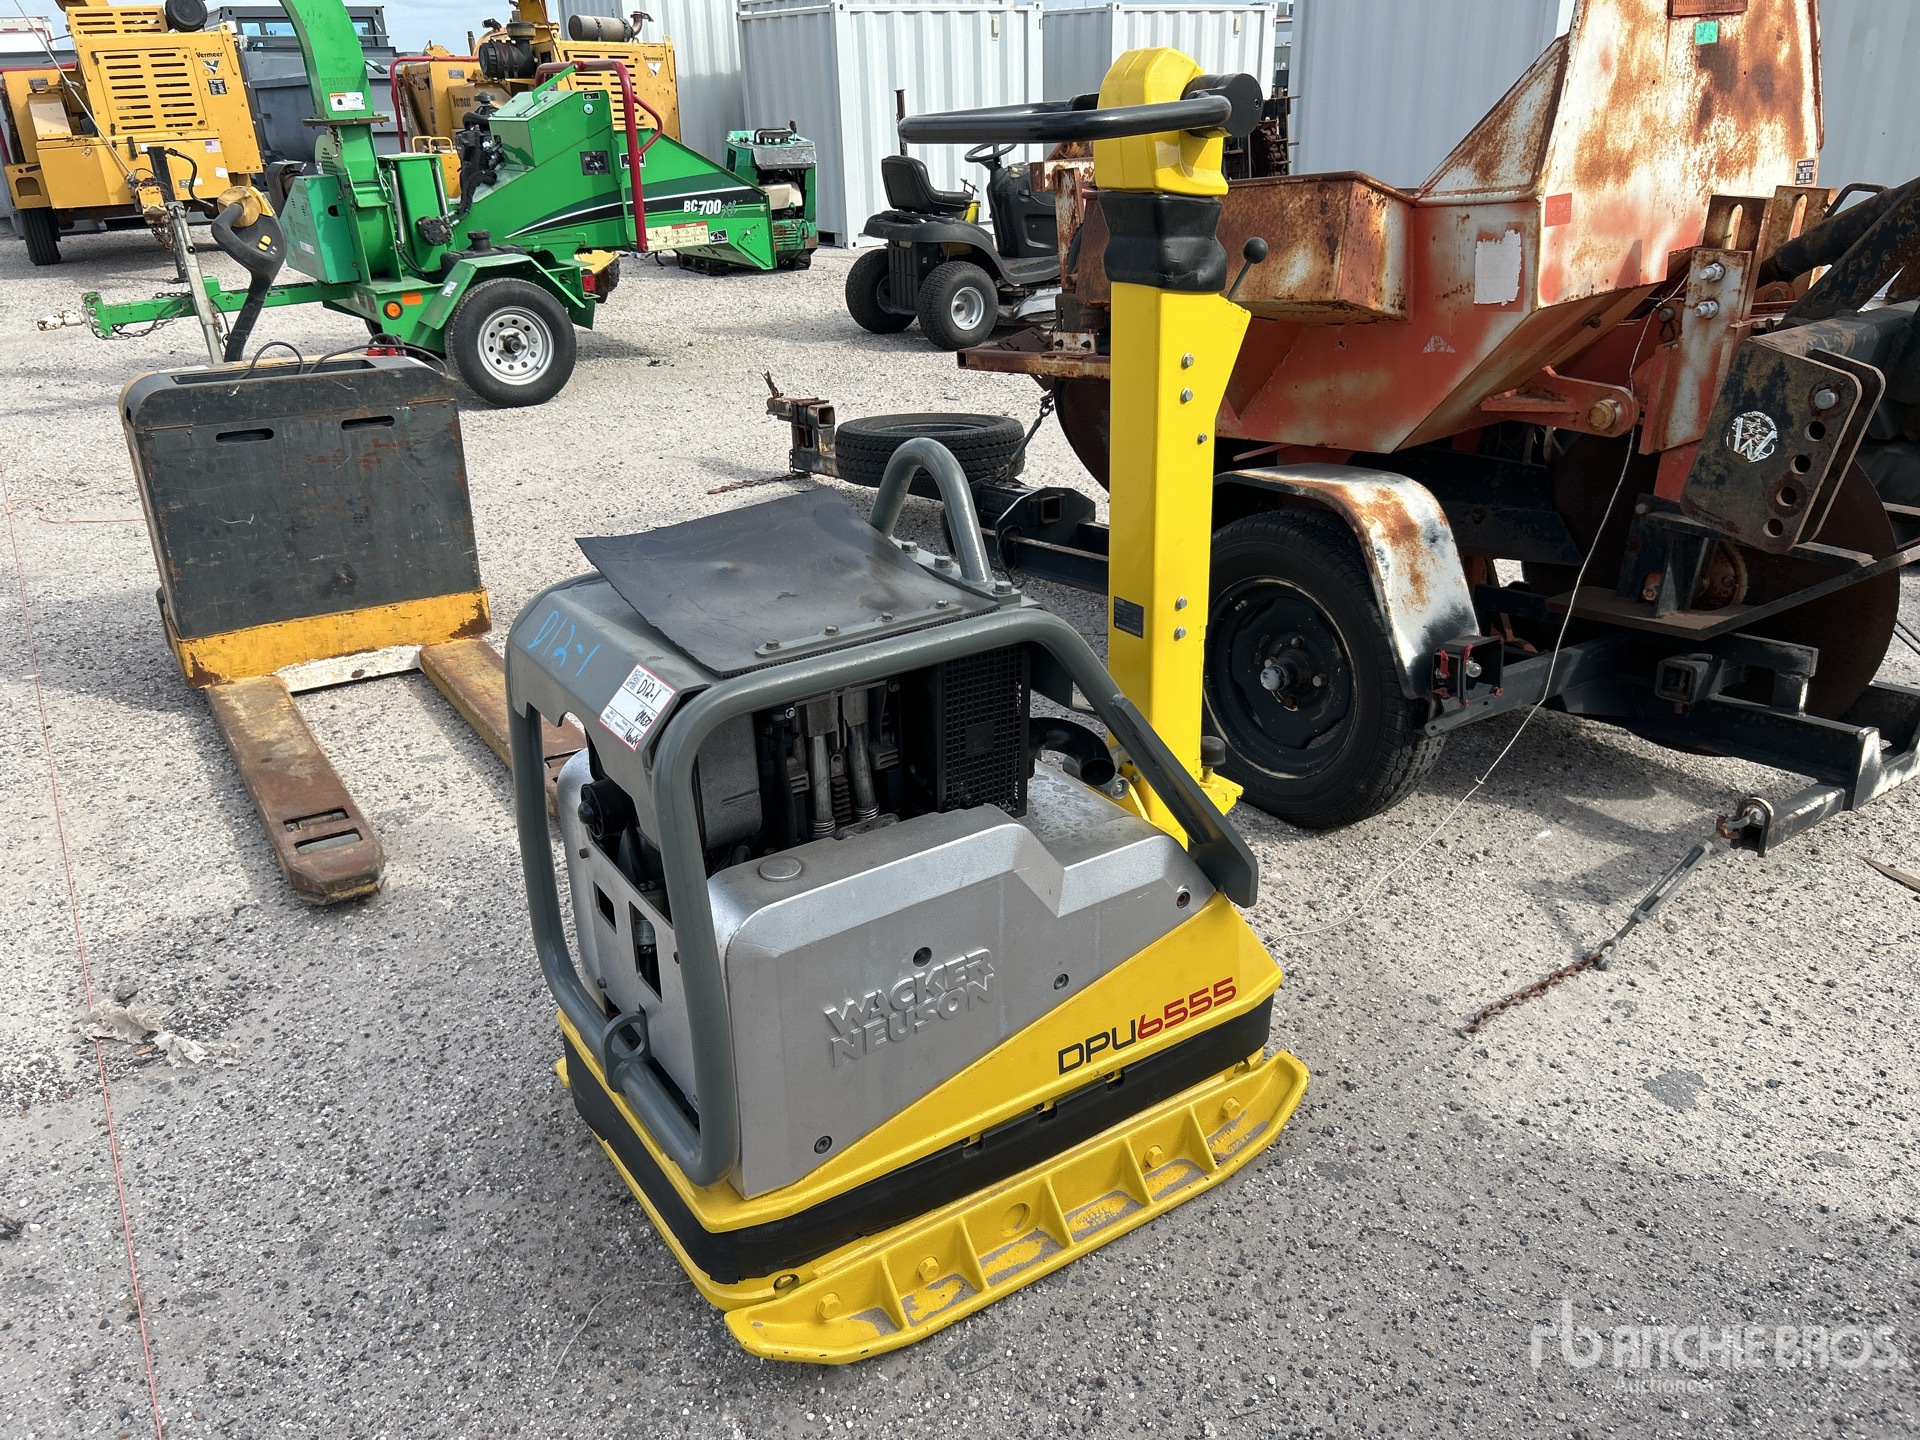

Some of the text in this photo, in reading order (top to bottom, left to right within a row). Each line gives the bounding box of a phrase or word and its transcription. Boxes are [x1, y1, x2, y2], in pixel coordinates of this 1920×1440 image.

[824, 948, 995, 1037] WACKER
[830, 972, 995, 1069] NEUSON
[1057, 976, 1238, 1076] DPU6555
